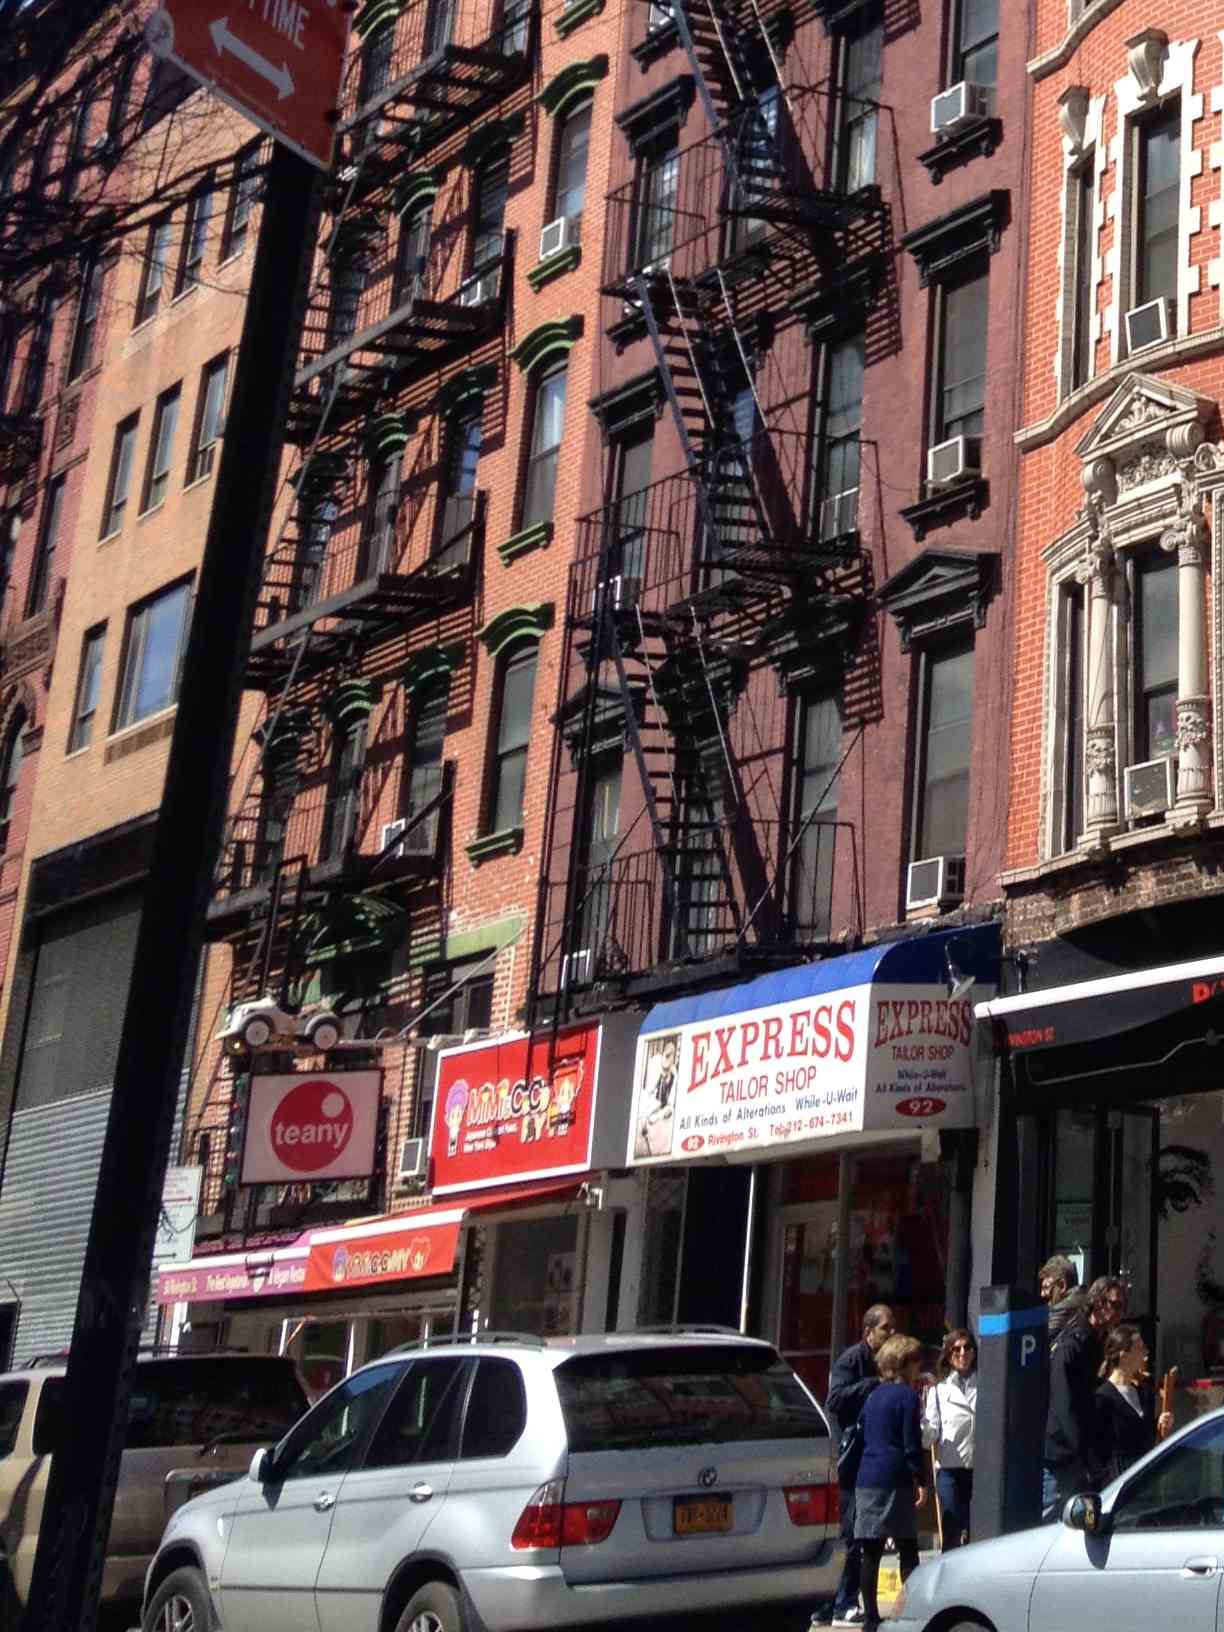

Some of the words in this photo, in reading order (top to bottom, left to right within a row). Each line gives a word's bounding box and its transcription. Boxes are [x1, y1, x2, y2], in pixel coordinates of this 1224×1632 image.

[874, 1000, 973, 1048] EXPRESS
[687, 999, 856, 1093] EXPRESS
[892, 1044, 926, 1060] TAILOR
[928, 1044, 954, 1060] SHOP
[719, 1074, 769, 1105] TAILOR
[775, 1065, 817, 1095] SHOP
[679, 1116, 691, 1131] All
[694, 1111, 718, 1129] Kinds
[722, 1109, 733, 1123] of
[736, 1102, 786, 1122] Alterations
[908, 1100, 934, 1115] 92
[274, 1120, 349, 1150] teany
[707, 1130, 745, 1148] Rivington
[748, 1126, 759, 1139] St.
[1021, 1335, 1036, 1366] P
